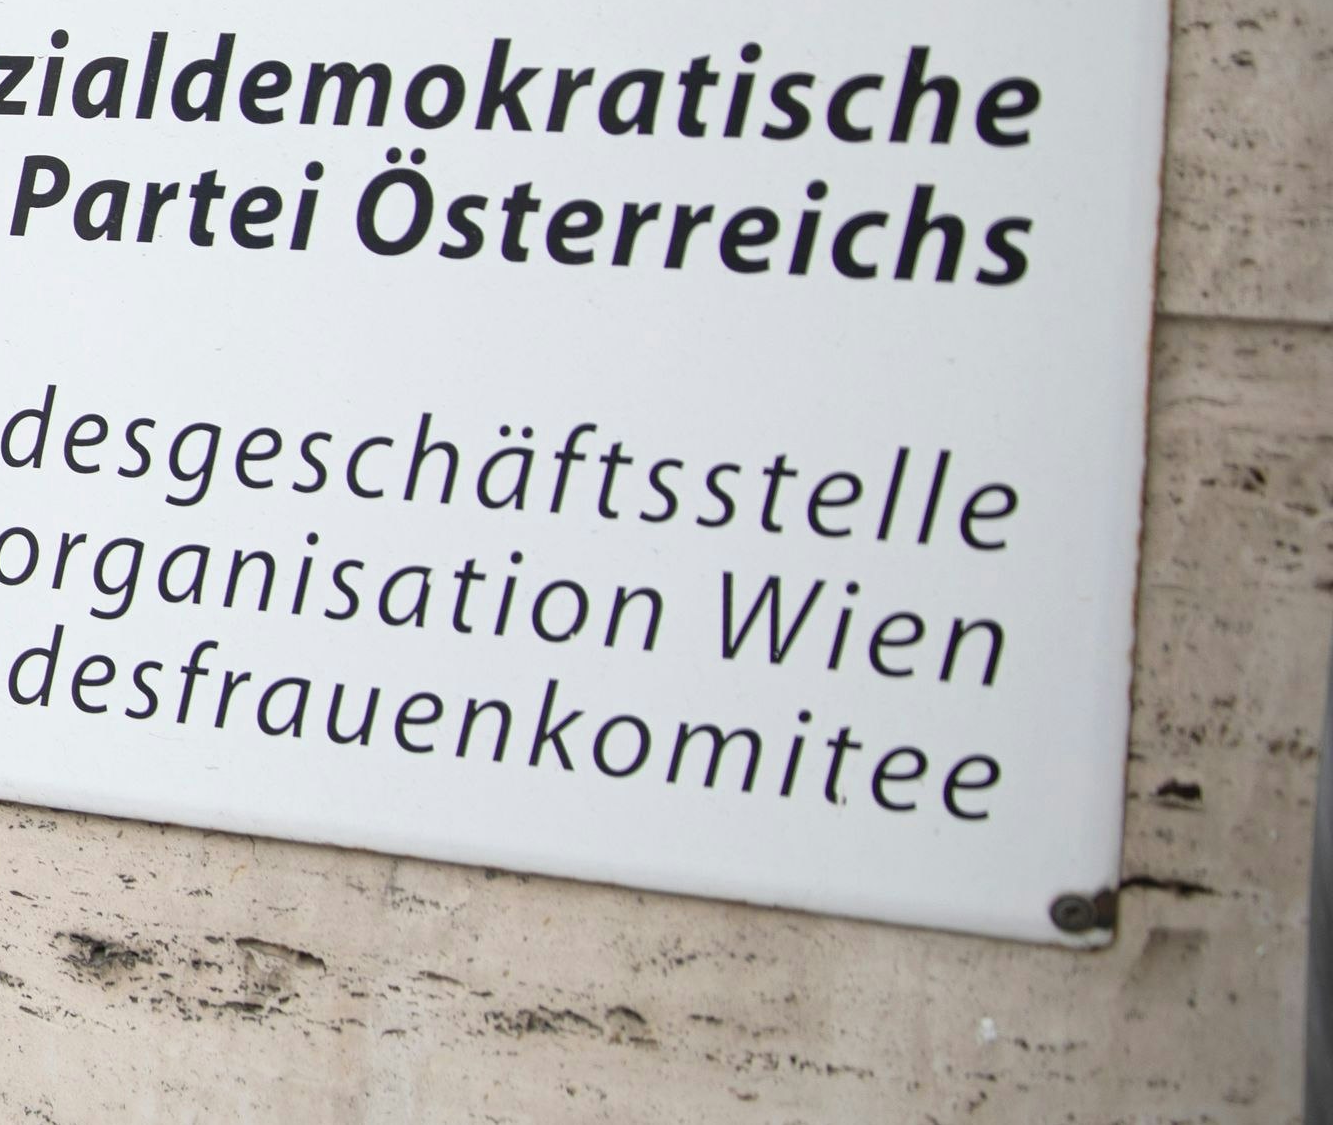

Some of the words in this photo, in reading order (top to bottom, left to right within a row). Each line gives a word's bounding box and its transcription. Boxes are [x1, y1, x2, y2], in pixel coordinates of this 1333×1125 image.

[8, 154, 325, 251] Partei
[355, 146, 1033, 287] Österreichs
[721, 571, 1006, 687] Wien
